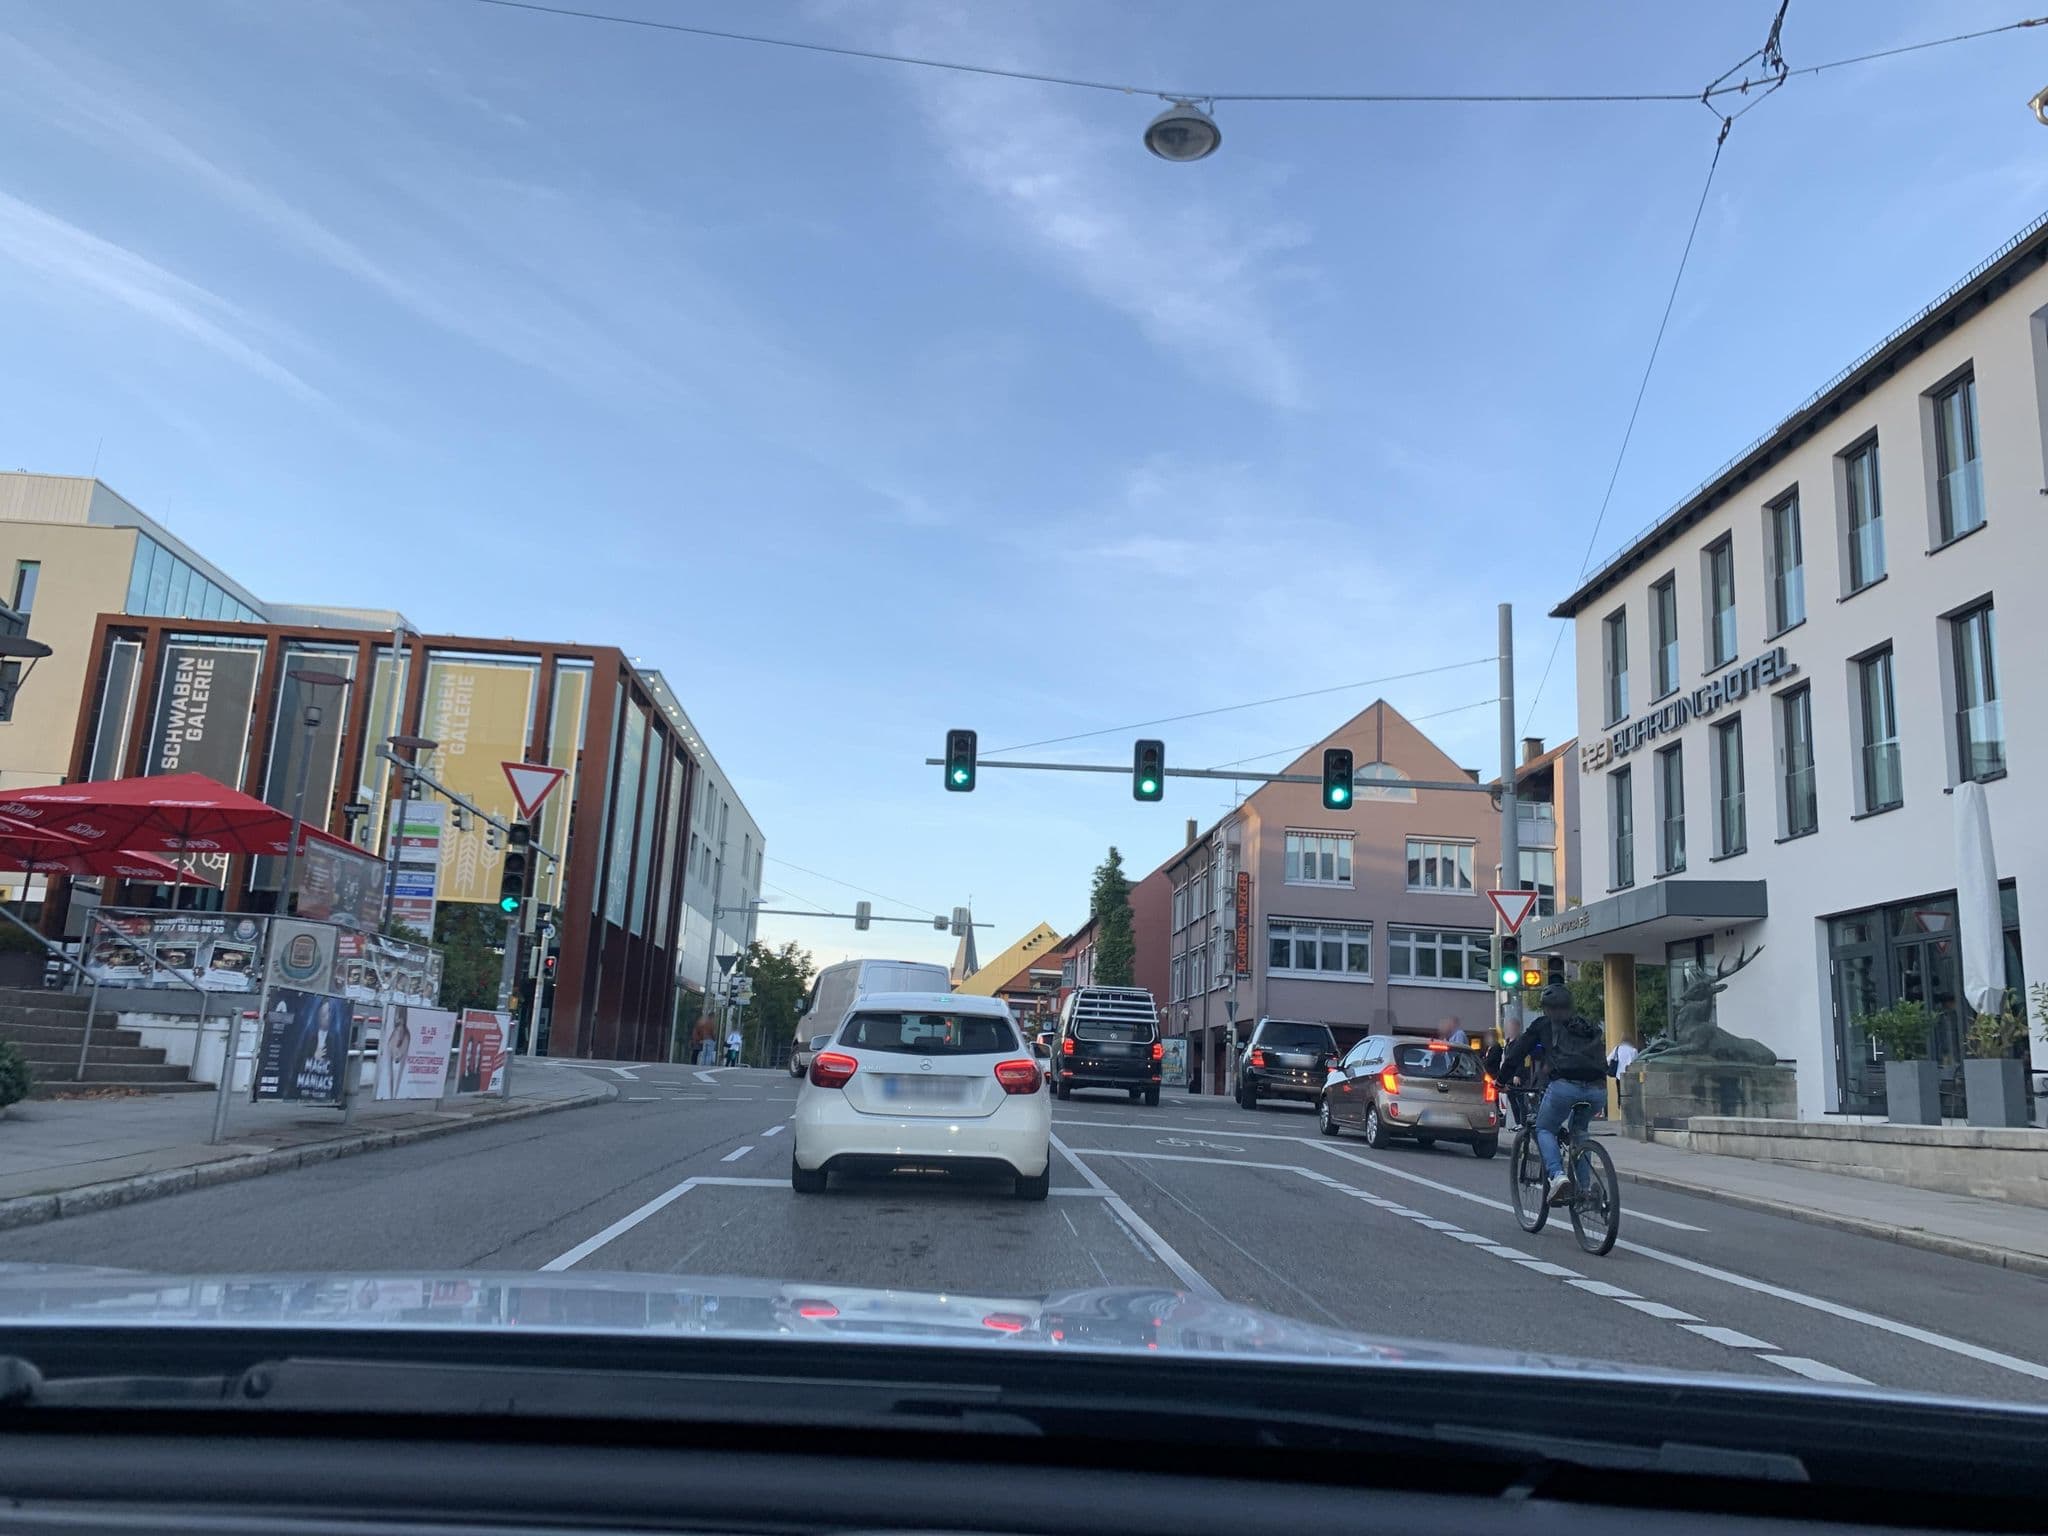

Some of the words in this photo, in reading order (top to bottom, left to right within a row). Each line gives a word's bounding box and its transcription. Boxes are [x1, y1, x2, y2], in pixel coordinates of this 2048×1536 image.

[161, 657, 195, 769] SCHWABEN
[185, 659, 214, 741] GALERIE
[448, 674, 474, 755] GALERIE
[1613, 646, 1798, 757] BOARDINGHOTEL
[296, 1073, 333, 1090] MANIACS
[304, 1058, 330, 1074] MAGIC
